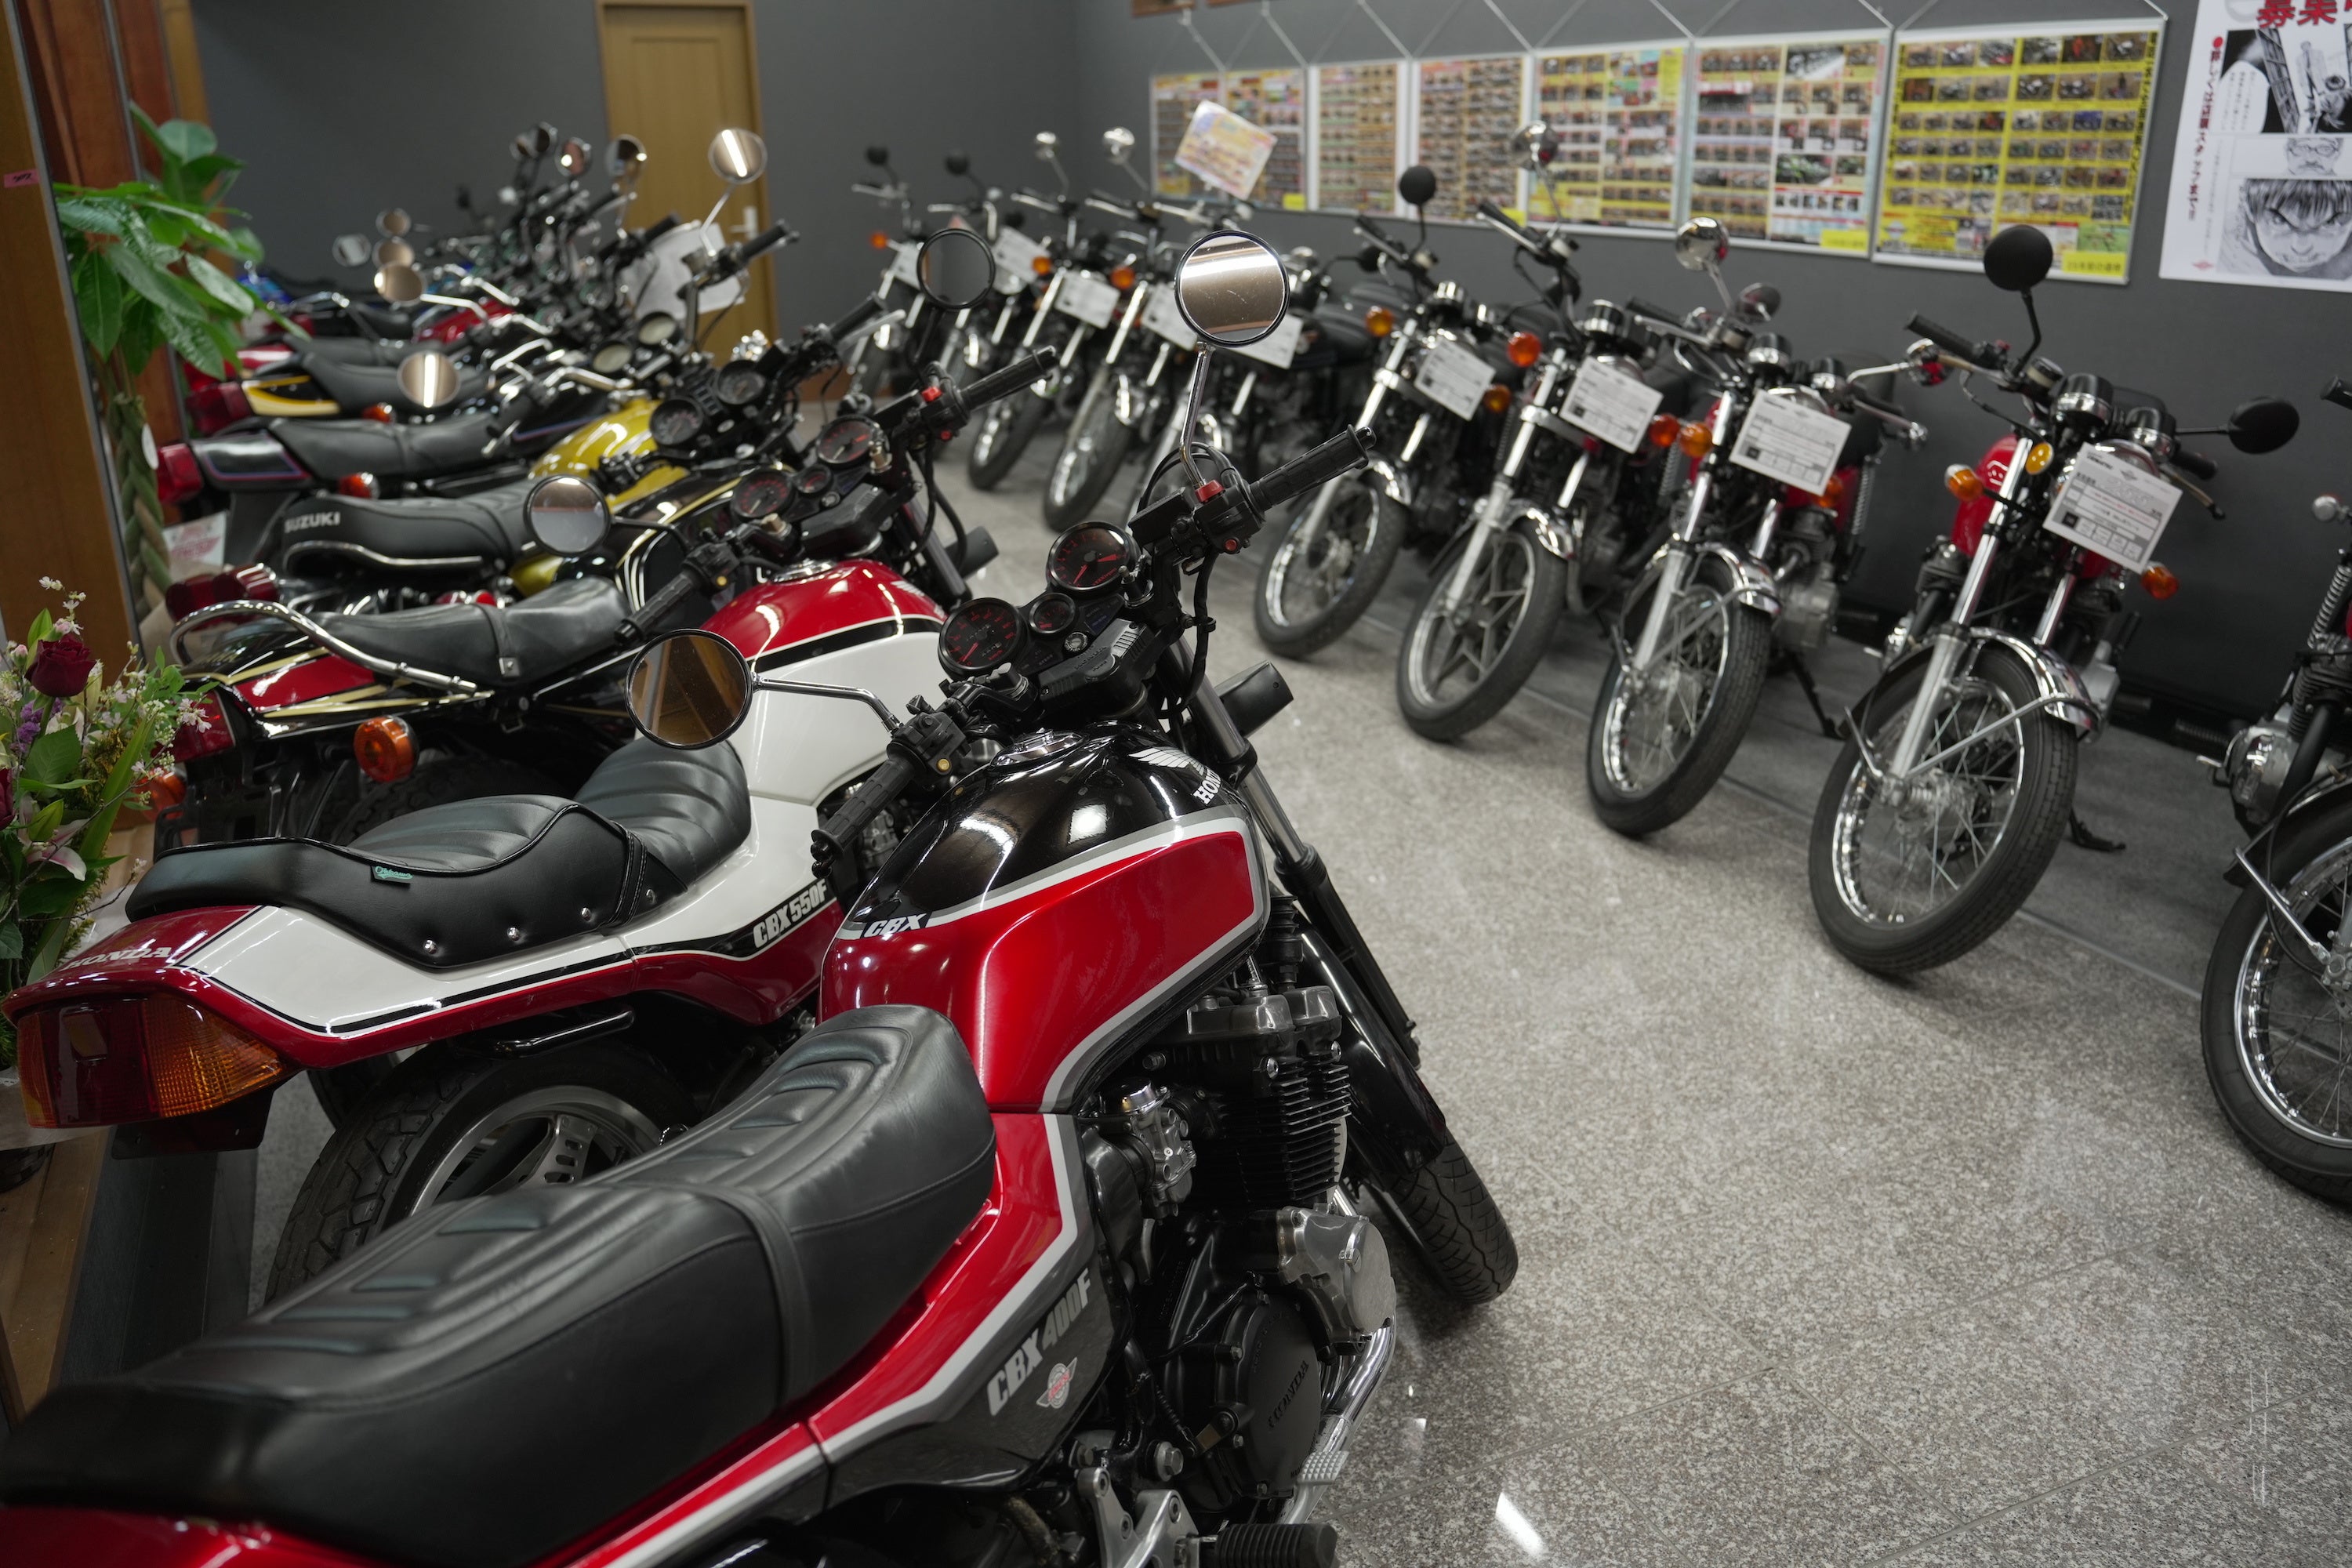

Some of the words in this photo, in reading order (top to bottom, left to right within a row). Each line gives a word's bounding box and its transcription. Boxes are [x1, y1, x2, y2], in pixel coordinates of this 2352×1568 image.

[285, 511, 340, 533] SUZUKI
[864, 913, 927, 938] CBX
[59, 947, 172, 972] HONDA
